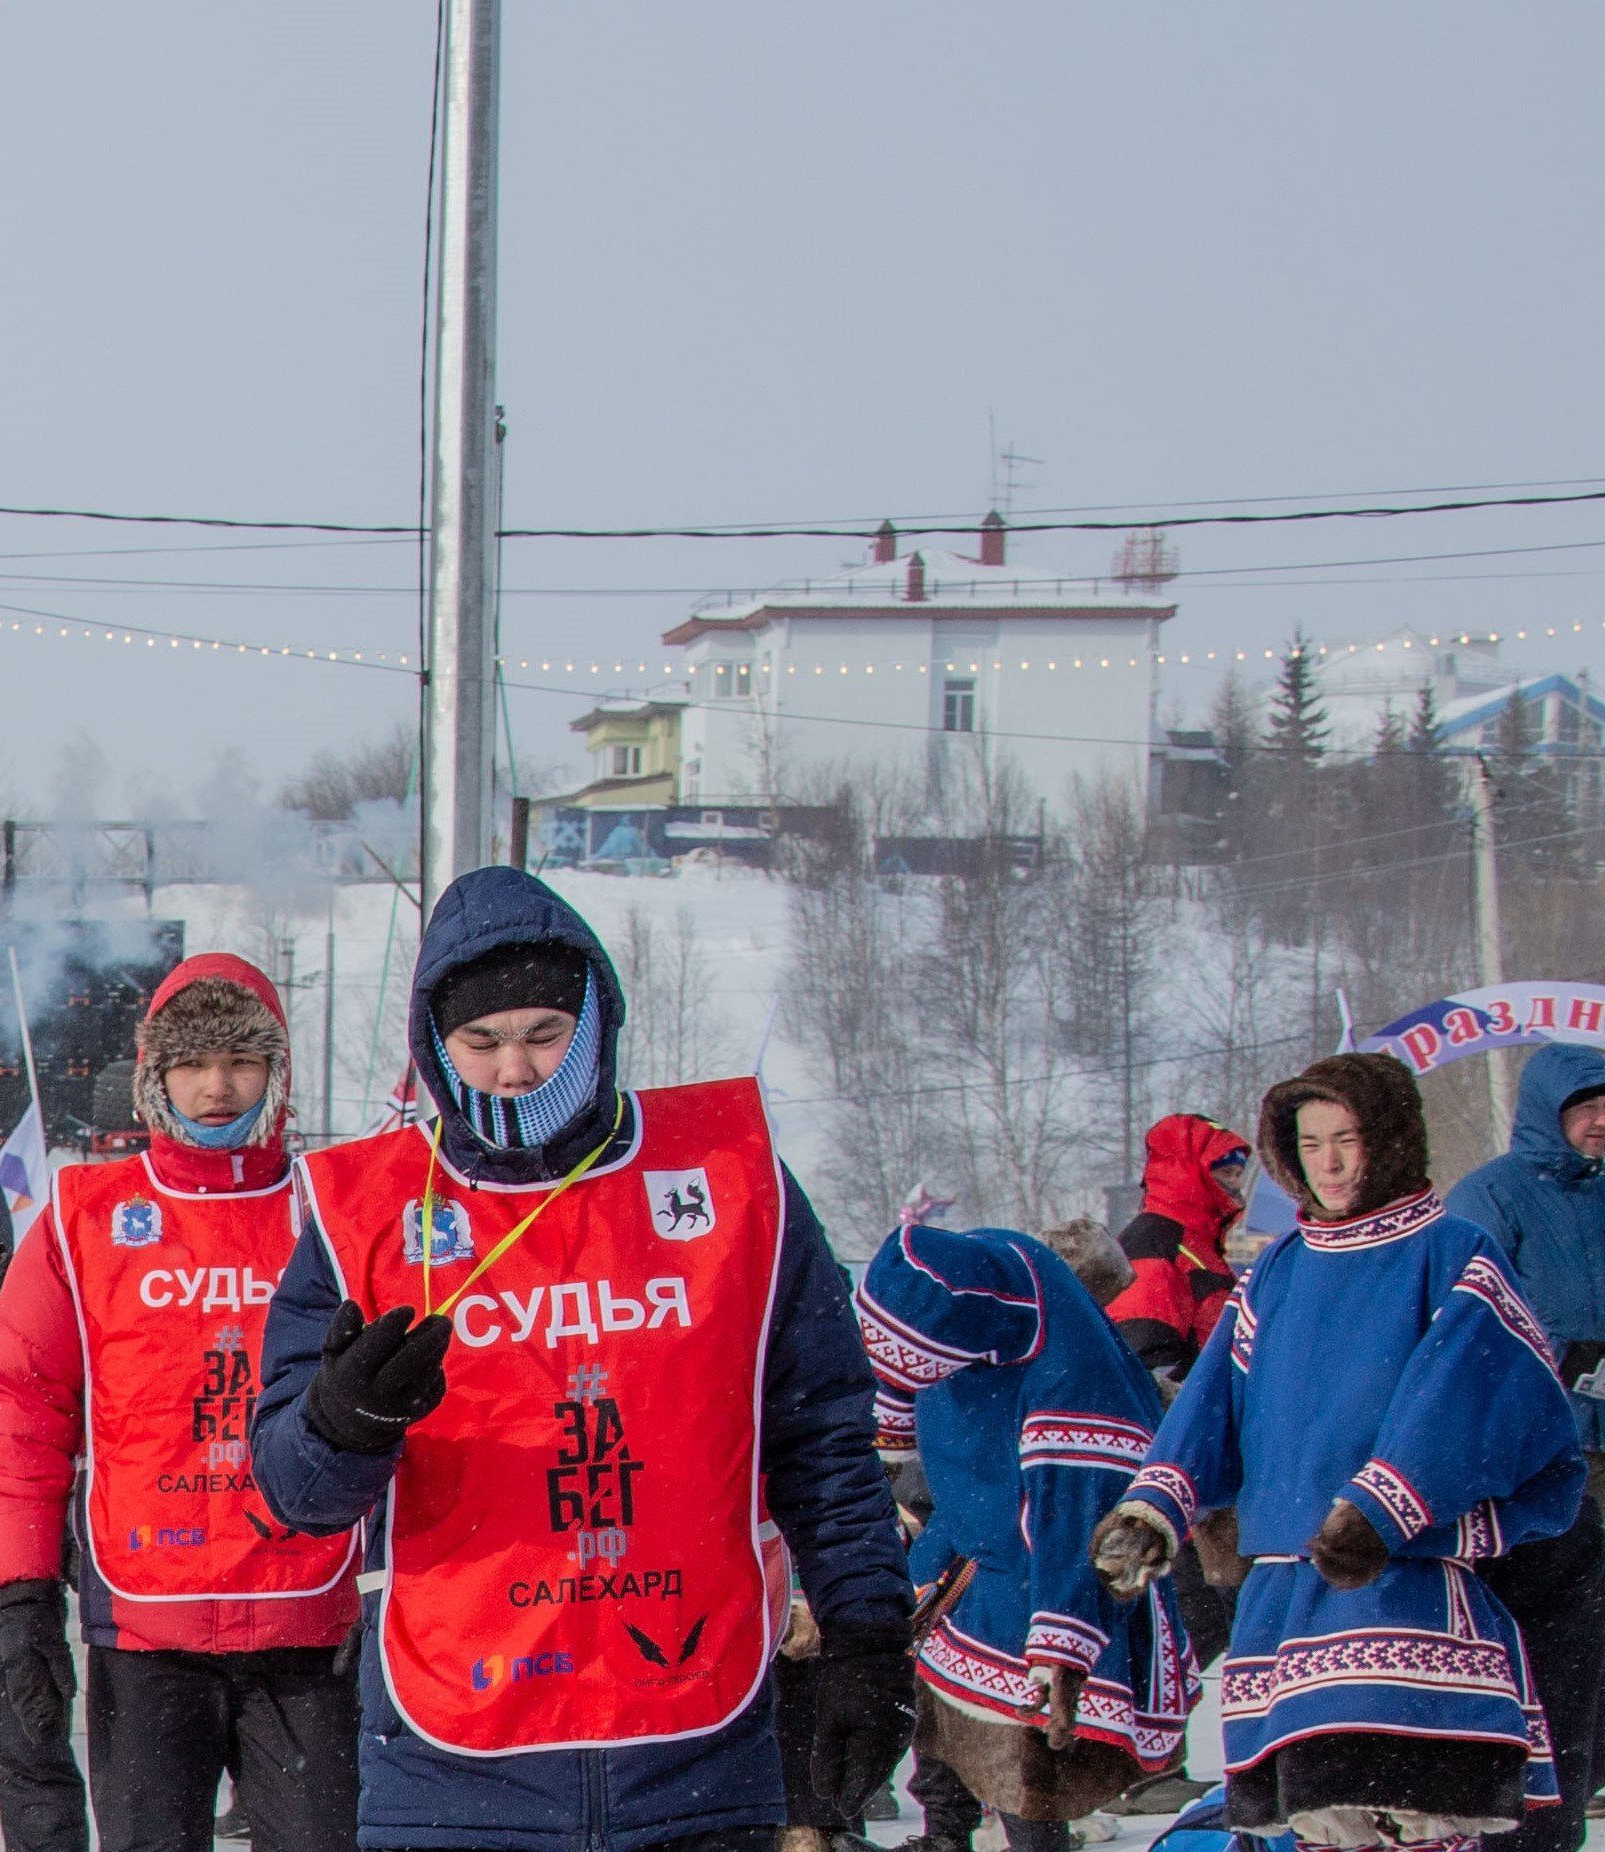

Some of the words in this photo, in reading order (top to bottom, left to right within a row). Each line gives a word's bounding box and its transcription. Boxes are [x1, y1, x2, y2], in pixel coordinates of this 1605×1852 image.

[139, 1267, 287, 1313] СУДЬ
[453, 1276, 693, 1349] СУДЬЯ
[203, 1350, 255, 1396] ЗА
[554, 1398, 631, 1466] ЗА
[546, 1461, 645, 1532] БЕГ
[157, 1527, 206, 1546] ПСБ
[509, 1568, 683, 1608] САЛЕХАРД
[512, 1652, 575, 1682] ПСБ
